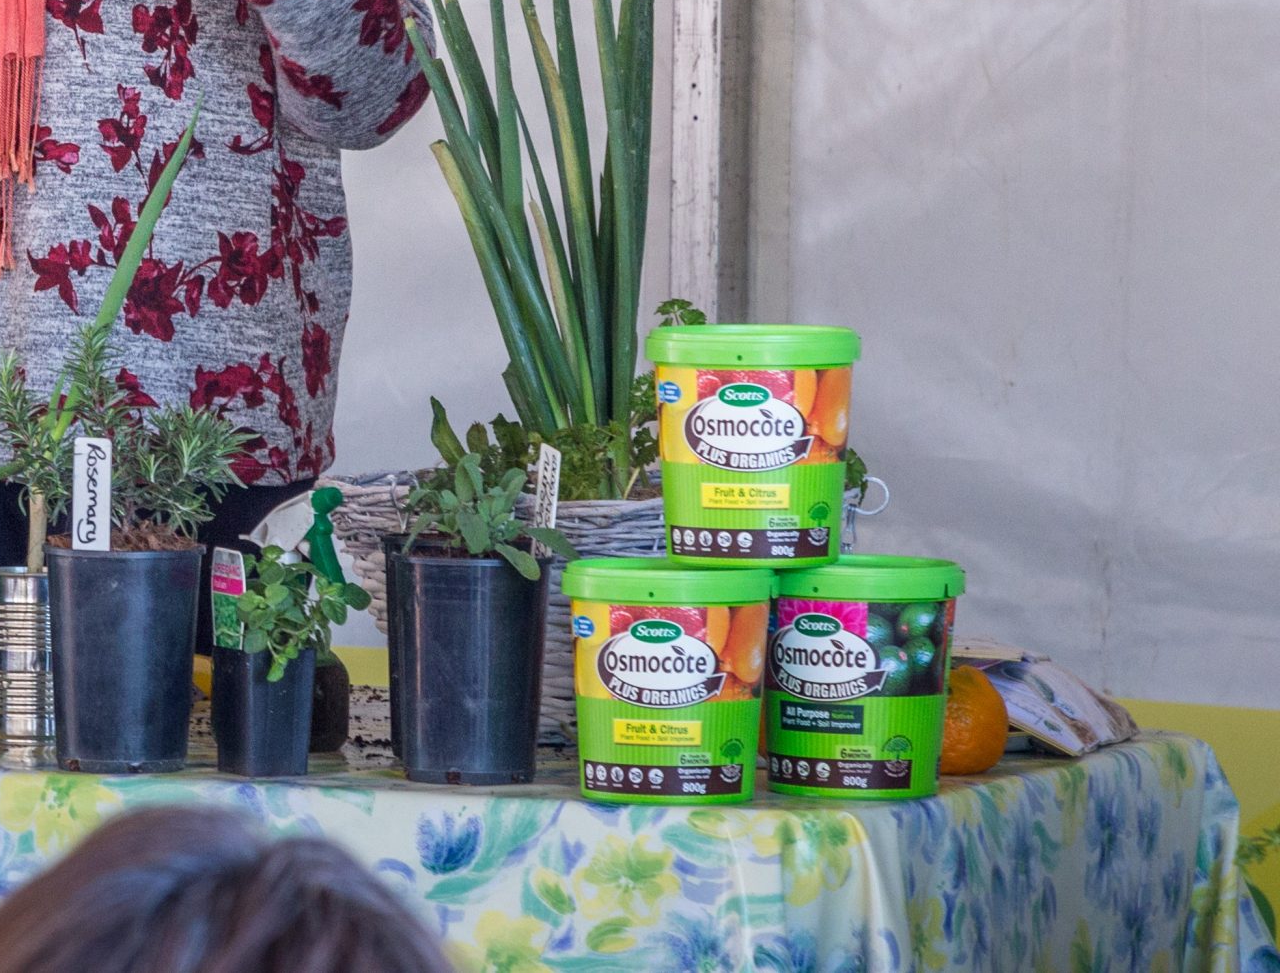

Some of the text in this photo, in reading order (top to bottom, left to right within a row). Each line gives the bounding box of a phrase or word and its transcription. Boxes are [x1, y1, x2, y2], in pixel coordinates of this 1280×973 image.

[724, 388, 764, 401] Scotts
[693, 415, 794, 437] Osmocote
[696, 440, 795, 468] PLUS ORGANICS
[77, 443, 107, 544] Rosemary
[714, 488, 777, 497] Fruit & Citrus
[771, 545, 795, 557] 800g
[636, 625, 676, 637] Scotts
[799, 618, 836, 631] Scotts
[606, 651, 707, 673] Osmocote
[776, 643, 867, 668] Osmocote
[608, 676, 708, 705] PLUS ORGANICS
[778, 670, 868, 698] PLUS ORGANICS
[786, 706, 796, 715] All
[797, 707, 830, 719] Purpose
[626, 724, 688, 734] Fruit & Citrus
[682, 782, 707, 794] 800g
[842, 776, 868, 788] 800g
